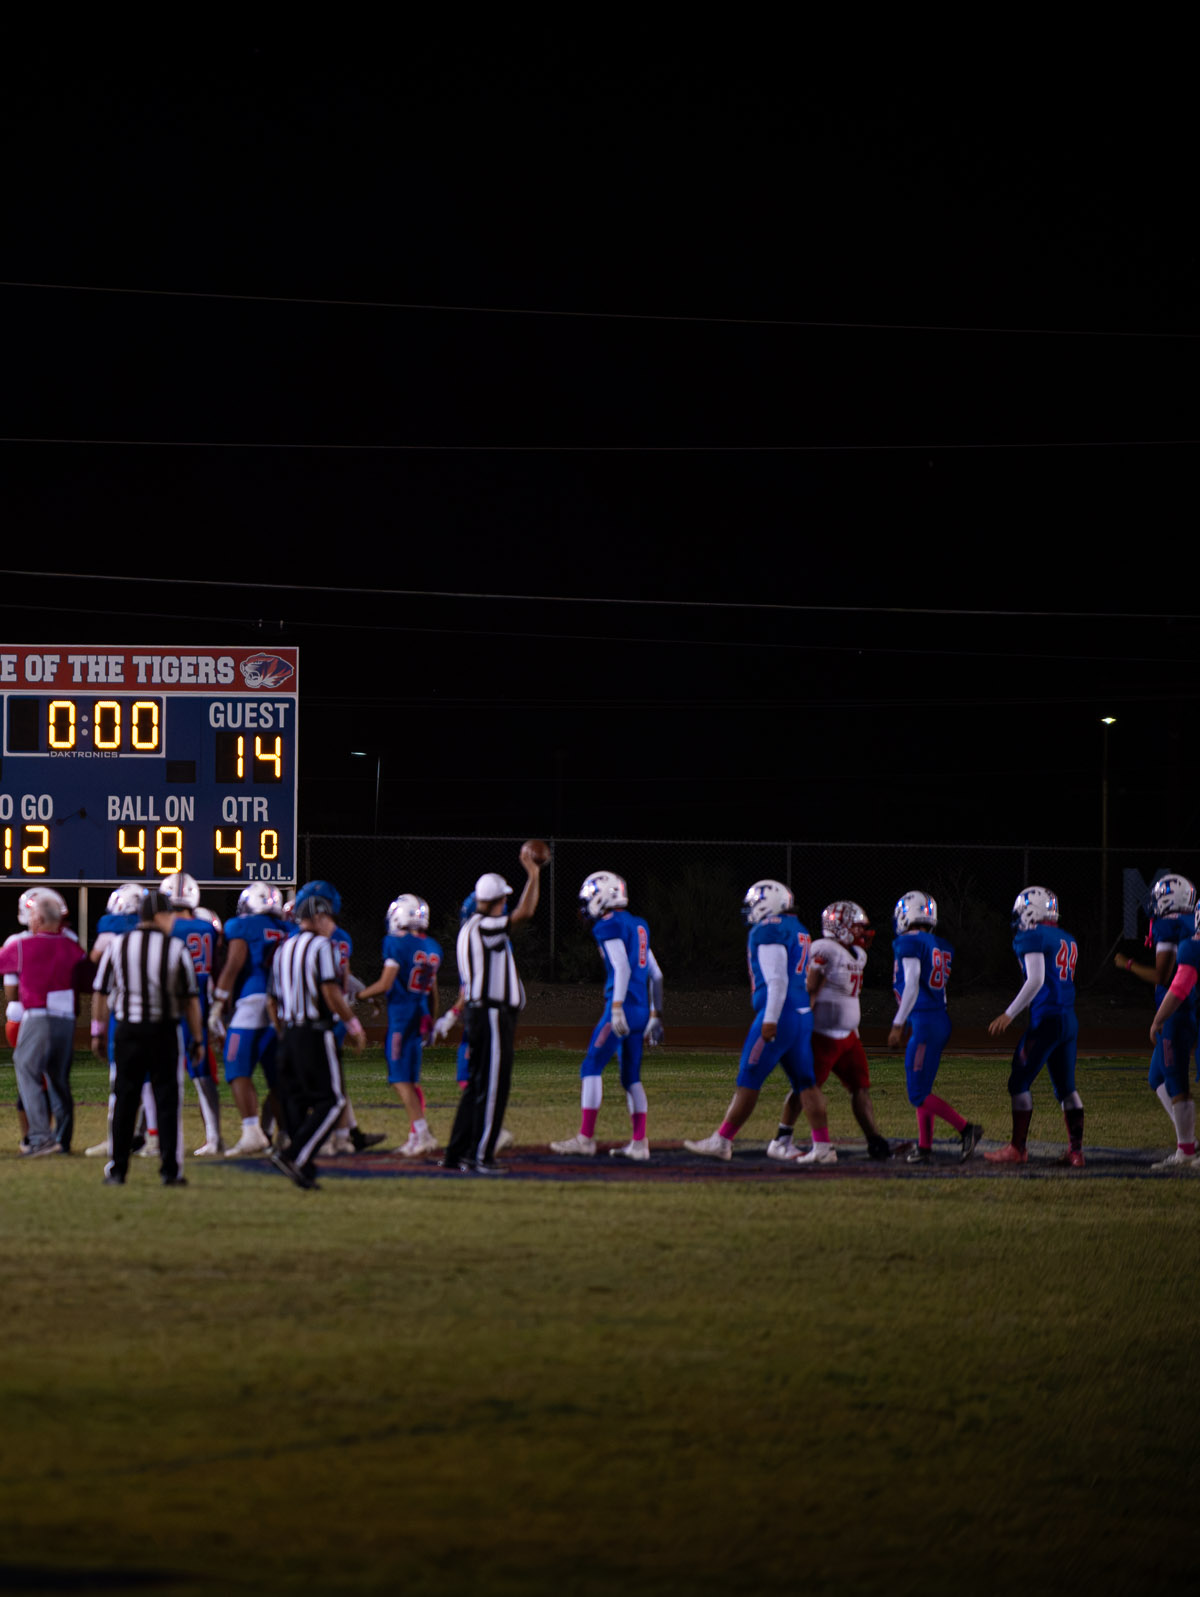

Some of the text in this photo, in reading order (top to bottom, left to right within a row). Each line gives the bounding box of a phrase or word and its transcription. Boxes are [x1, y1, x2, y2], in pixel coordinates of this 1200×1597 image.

[24, 654, 60, 682] OF
[67, 655, 125, 683] THE
[132, 655, 235, 684] TIGERS
[47, 700, 159, 750] 0:00
[208, 701, 290, 728] GUEST
[236, 735, 282, 778] 14
[20, 794, 54, 821] GO
[107, 796, 195, 822] BALL ON
[221, 796, 269, 824] QTR
[3, 825, 50, 873] 12
[117, 825, 183, 874] 48
[214, 828, 242, 872] 4
[260, 829, 278, 859] 0
[245, 862, 292, 881] T.O.L.
[186, 932, 213, 974] 21
[928, 946, 953, 991] 85
[1055, 938, 1079, 982] 44
